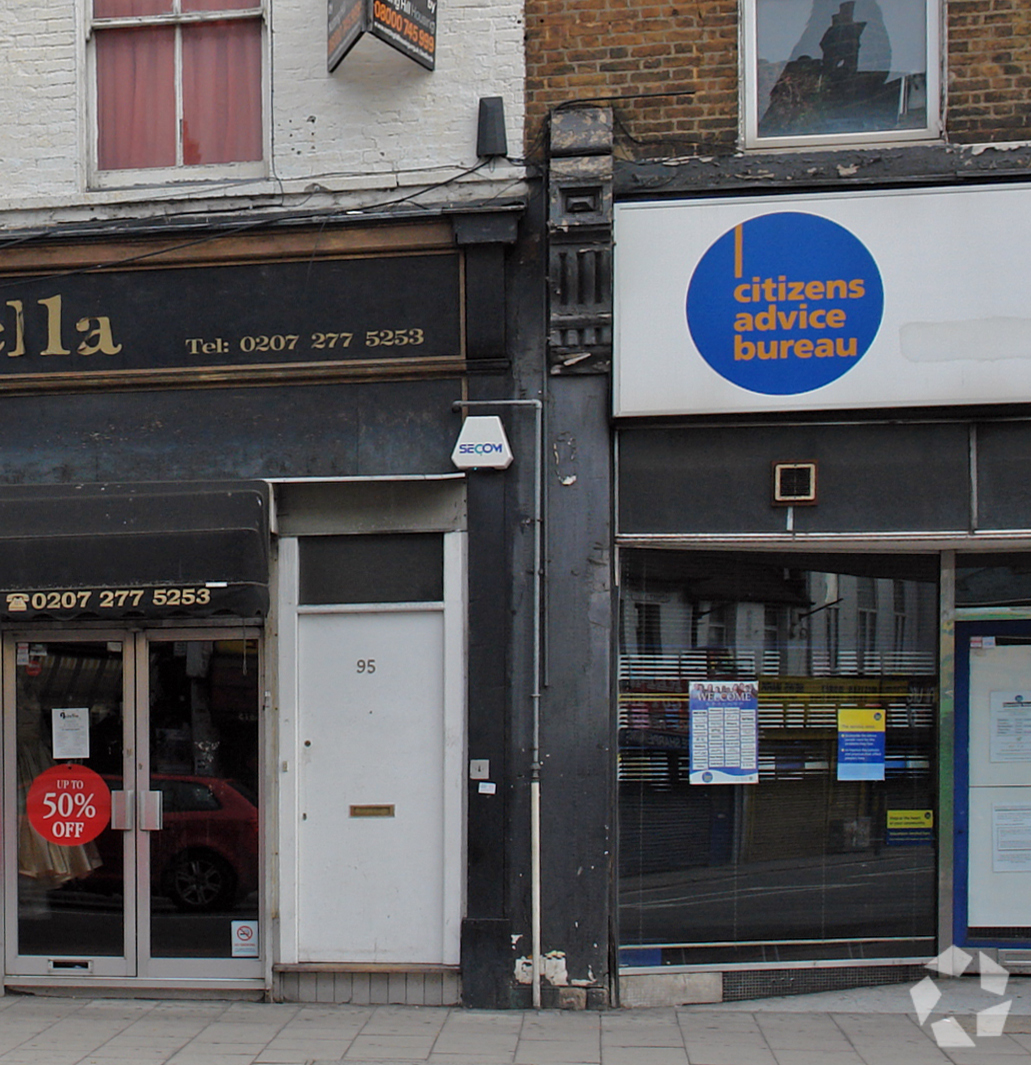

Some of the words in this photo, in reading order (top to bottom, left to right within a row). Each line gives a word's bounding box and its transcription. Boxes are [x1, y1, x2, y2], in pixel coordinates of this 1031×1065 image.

[374, 0, 403, 32] 08000
[733, 275, 866, 303] citizens
[733, 303, 847, 332] advice
[185, 338, 229, 355] Tel:
[239, 335, 300, 353] 0207
[311, 332, 354, 349] 277
[365, 328, 425, 347] 5253
[733, 334, 858, 361] bureau
[459, 443, 503, 455] SECOM
[30, 590, 92, 610] 0207
[99, 589, 145, 608] 277
[152, 588, 211, 606] 5253
[356, 659, 376, 674] 95
[698, 692, 752, 702] WELCOME
[56, 779, 70, 789] UP
[71, 779, 84, 789] TO
[42, 792, 97, 819] 50%
[52, 821, 85, 838] OFF
